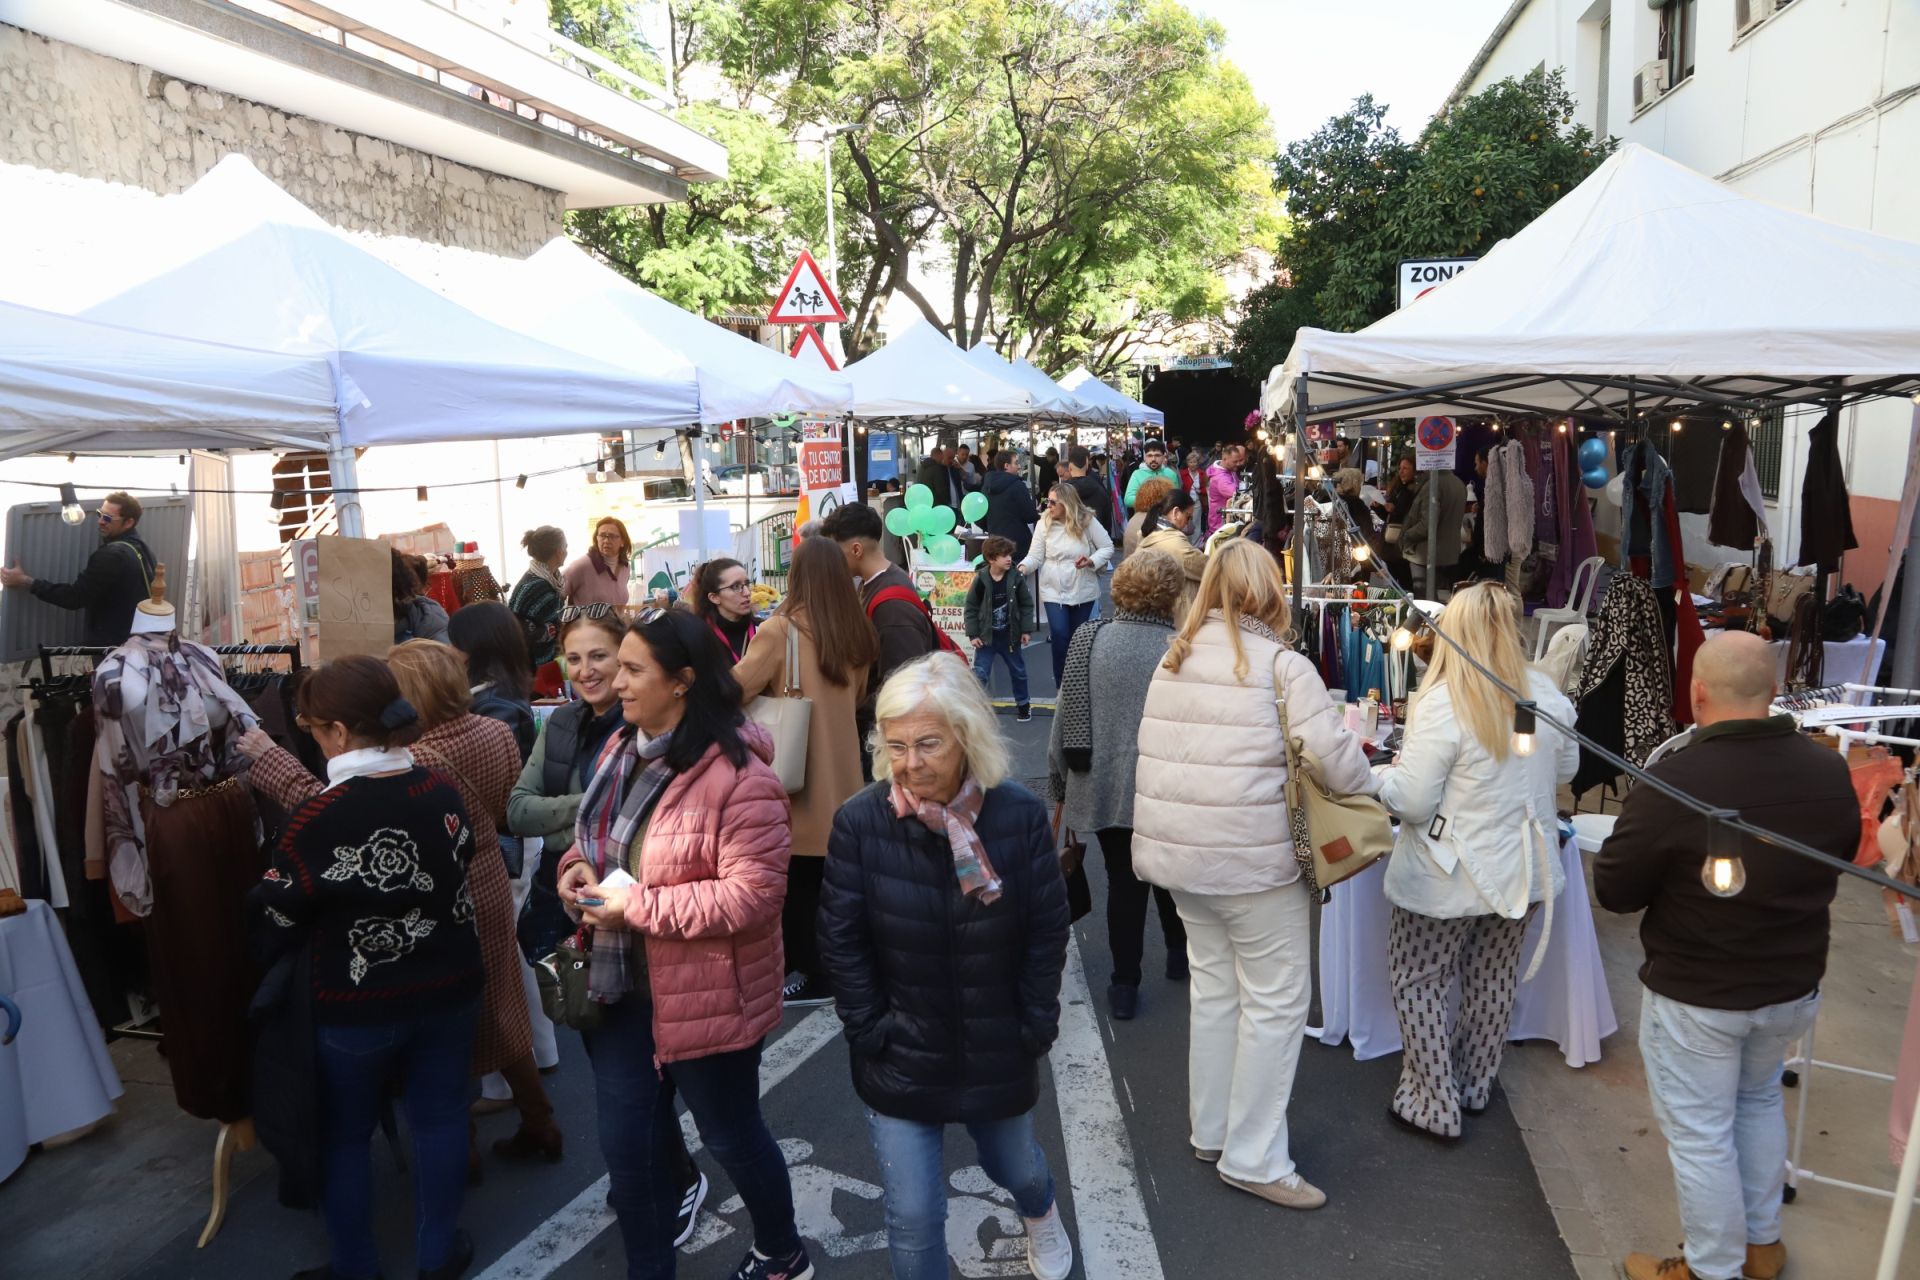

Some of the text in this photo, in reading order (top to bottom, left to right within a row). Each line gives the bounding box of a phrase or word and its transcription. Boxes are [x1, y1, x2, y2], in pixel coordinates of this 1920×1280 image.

[808, 450, 841, 466] TU CENTRO
[808, 468, 842, 484] DE IDIOMAS
[931, 607, 962, 617] CLASES
